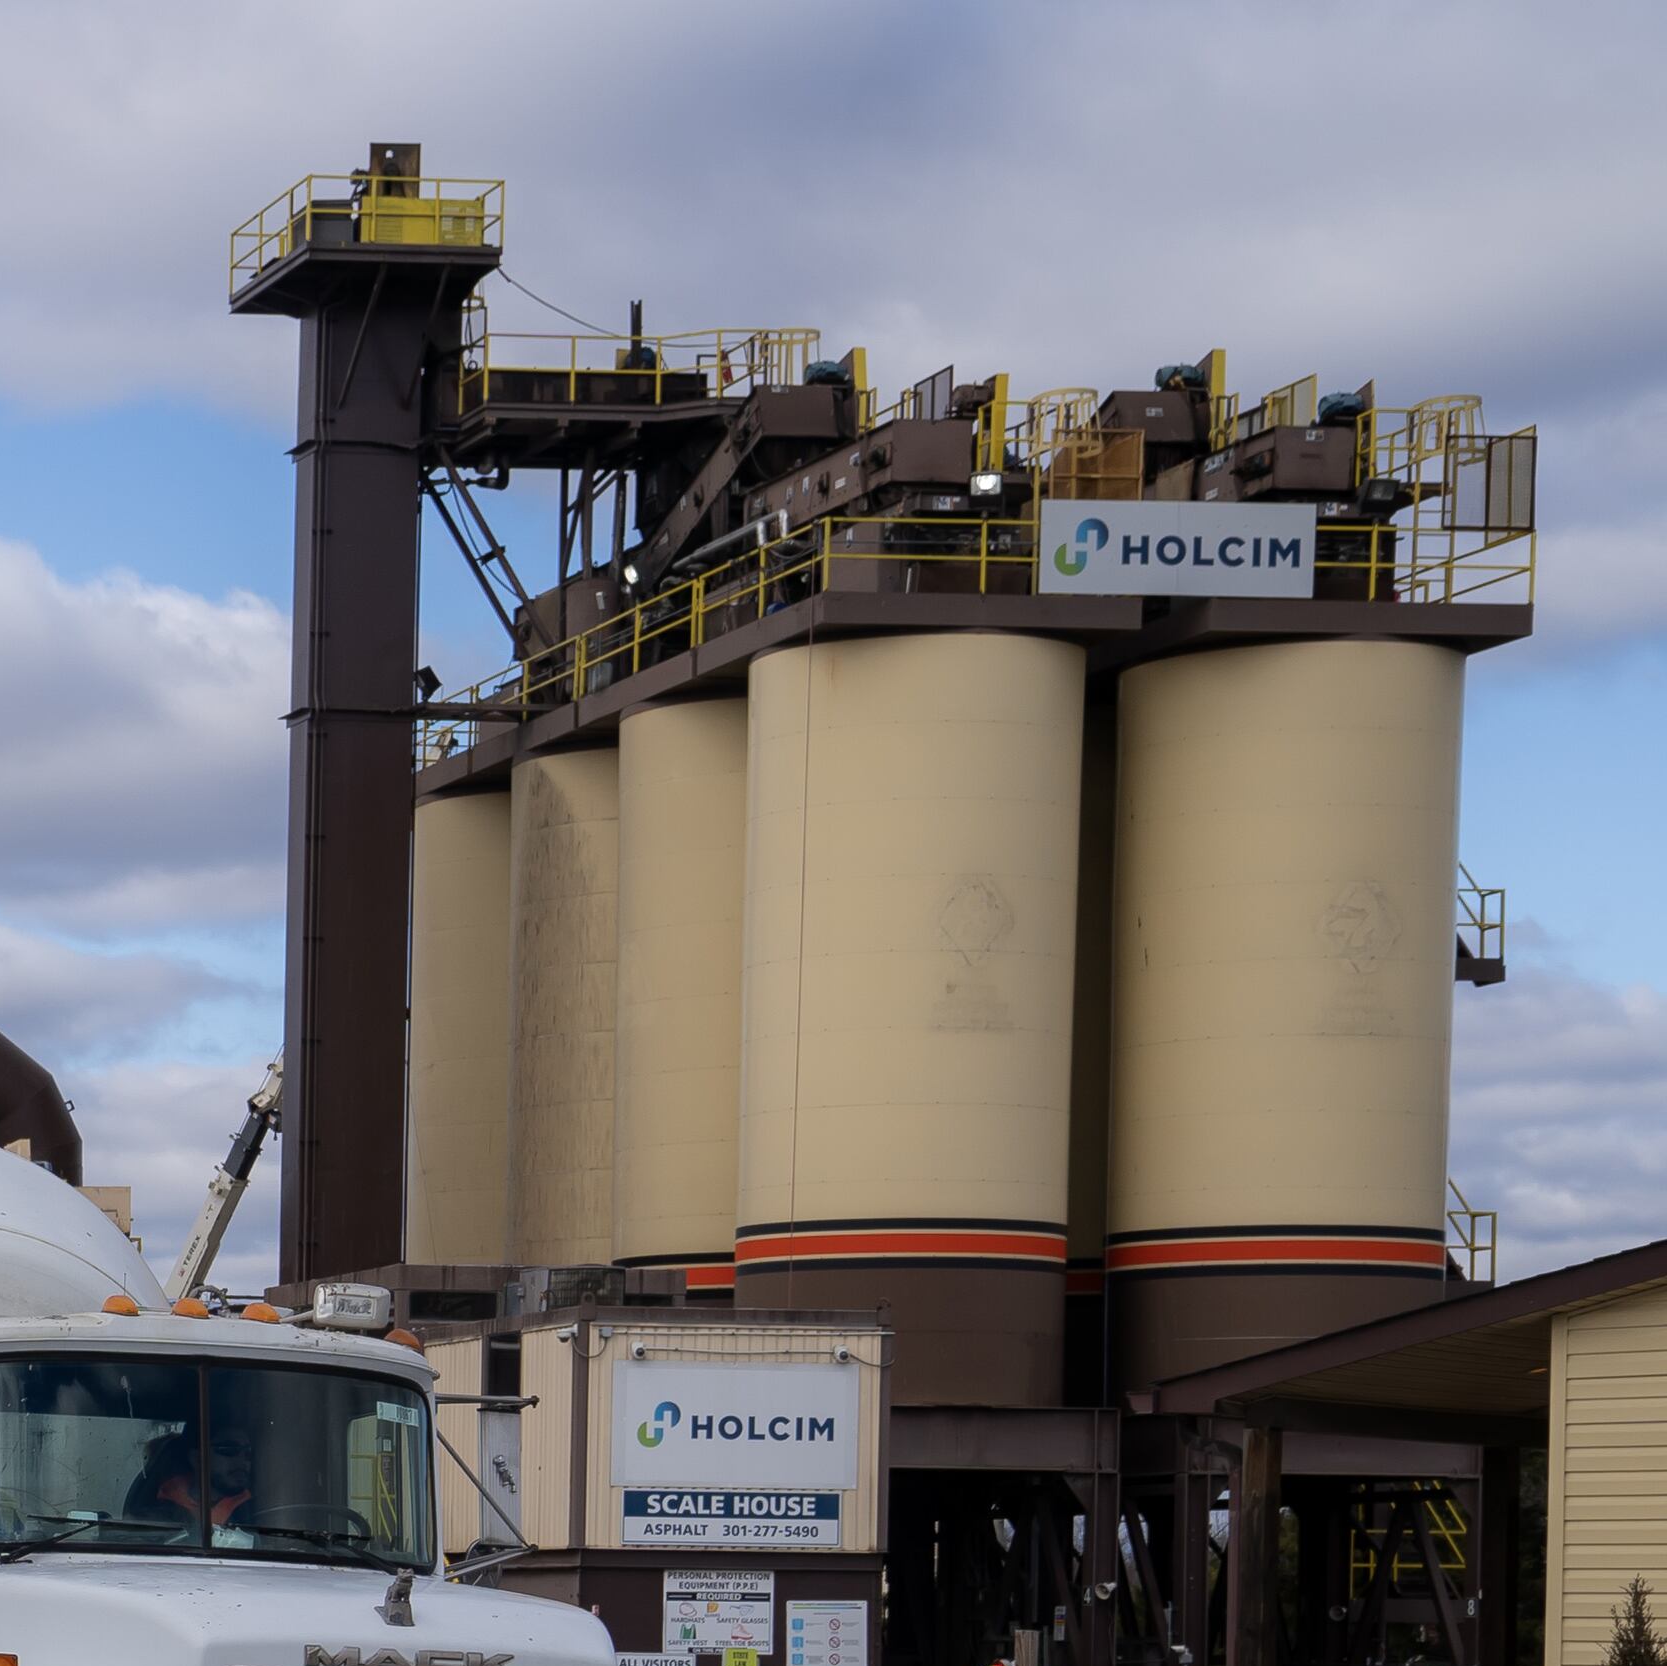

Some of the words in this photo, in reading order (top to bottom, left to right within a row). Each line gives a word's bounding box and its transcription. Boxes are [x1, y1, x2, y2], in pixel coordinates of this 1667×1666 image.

[1120, 535, 1301, 568] HOLCIM
[182, 1234, 201, 1266] TEREX
[691, 1415, 835, 1442] HOLCIM
[646, 1494, 725, 1515] SCALE
[733, 1496, 817, 1516] HOUSE
[644, 1523, 708, 1536] ASPHALT
[723, 1525, 819, 1538] 301-277-5490
[667, 1571, 713, 1580] PERSONAL
[716, 1571, 770, 1581] PROTECTION
[679, 1581, 729, 1590] EQUIPMENT
[1467, 1599, 1475, 1616] 8
